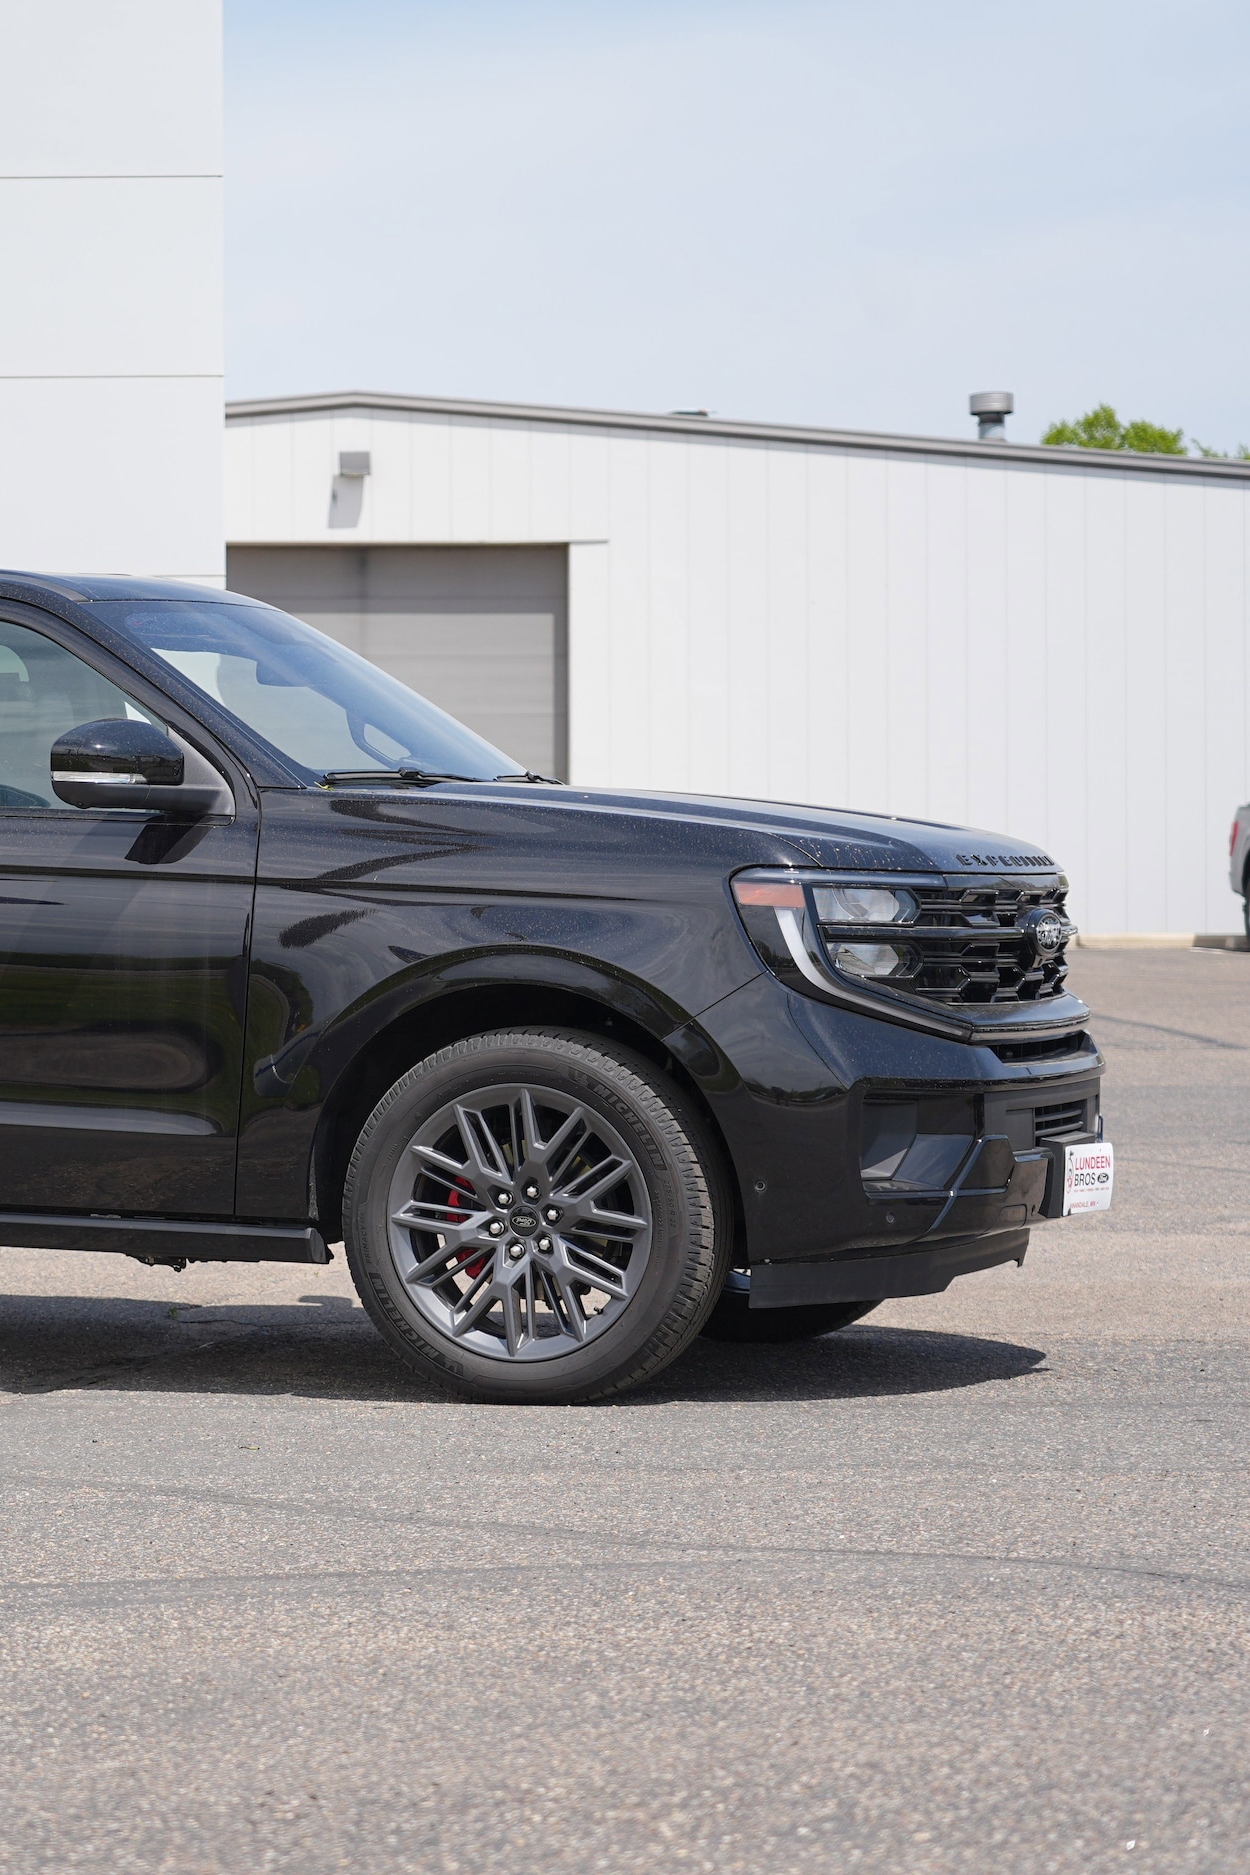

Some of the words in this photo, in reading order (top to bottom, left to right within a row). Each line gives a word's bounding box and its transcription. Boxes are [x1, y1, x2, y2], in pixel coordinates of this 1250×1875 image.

[593, 1084, 667, 1170] MICHELIN
[1074, 1172, 1096, 1186] BROS
[1075, 1156, 1110, 1170] LUNDEEN
[372, 1278, 440, 1360] MICHELIN
